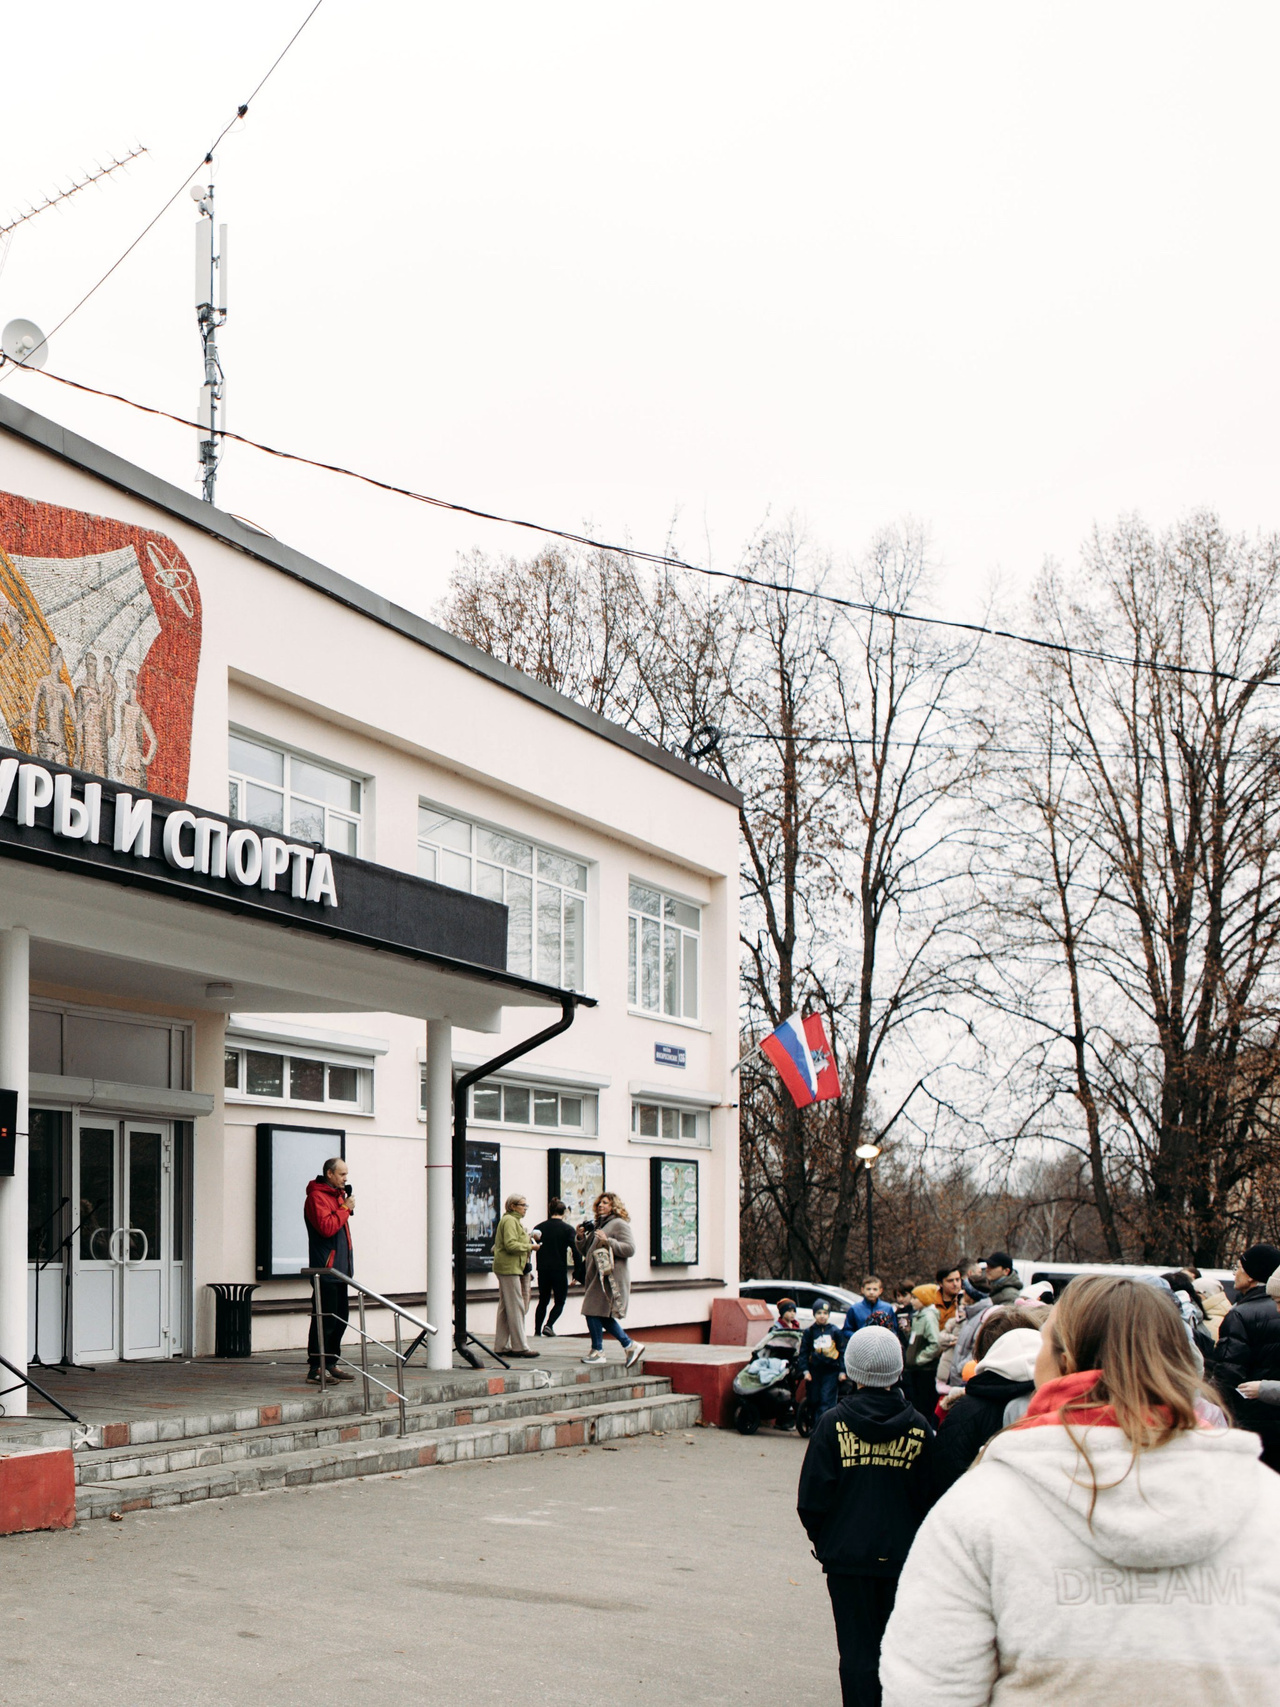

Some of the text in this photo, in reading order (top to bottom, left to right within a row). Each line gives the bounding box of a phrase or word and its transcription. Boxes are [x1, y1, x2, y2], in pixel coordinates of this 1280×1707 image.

[113, 792, 153, 858] И
[163, 810, 338, 908] СПОРТА
[1053, 1565, 1246, 1606] DREAM
